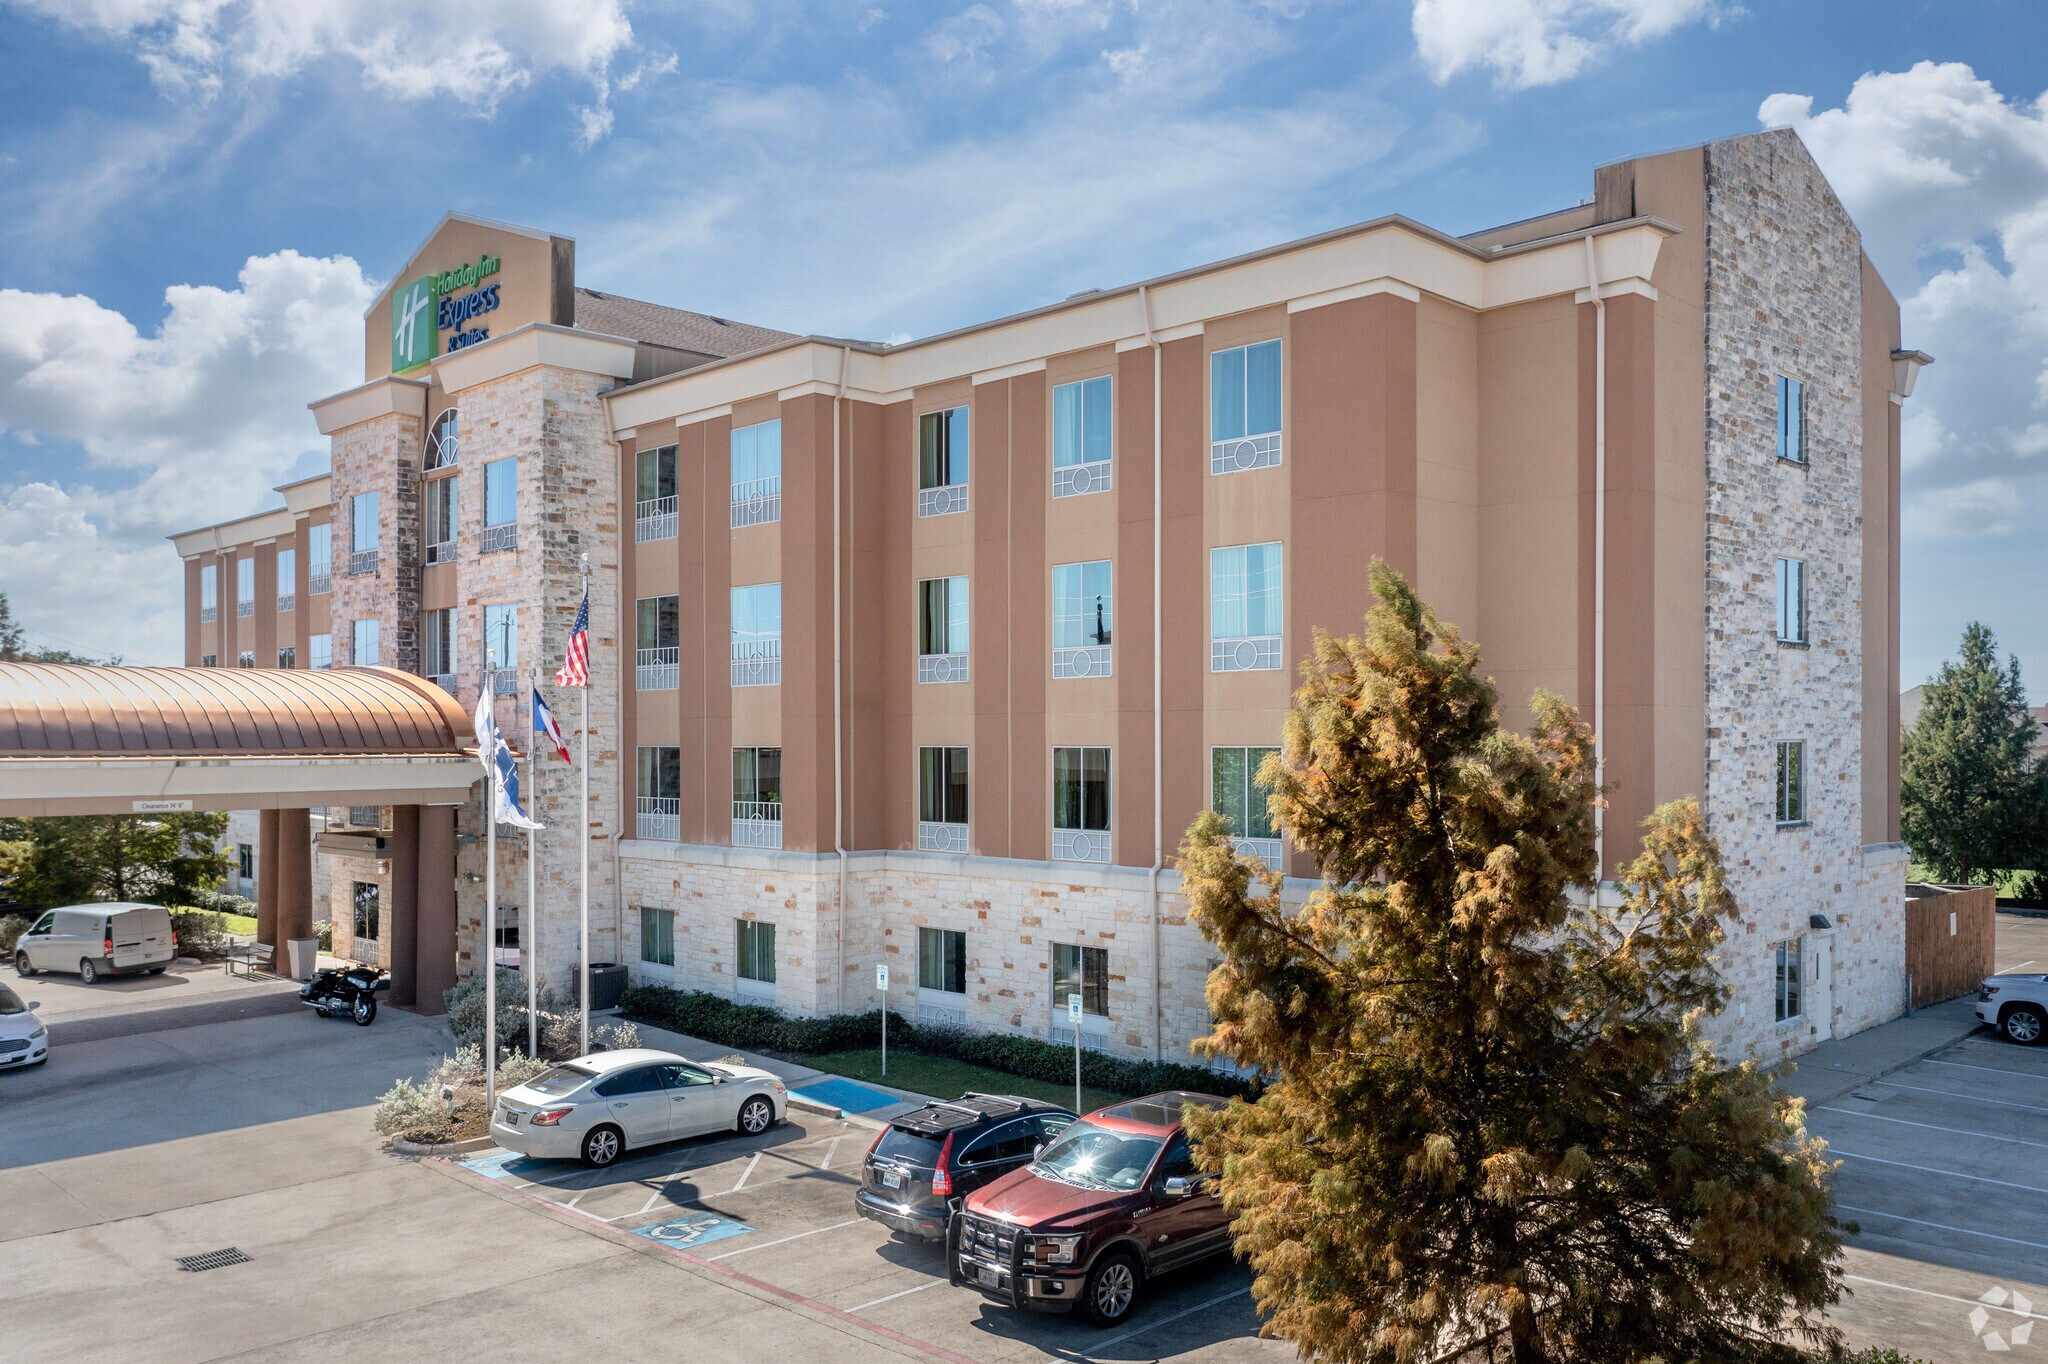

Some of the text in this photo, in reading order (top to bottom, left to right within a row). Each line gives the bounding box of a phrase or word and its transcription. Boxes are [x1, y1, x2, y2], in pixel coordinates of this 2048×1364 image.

[436, 254, 501, 295] Holiday Inn
[437, 283, 501, 332] Express
[457, 328, 489, 350] Suites
